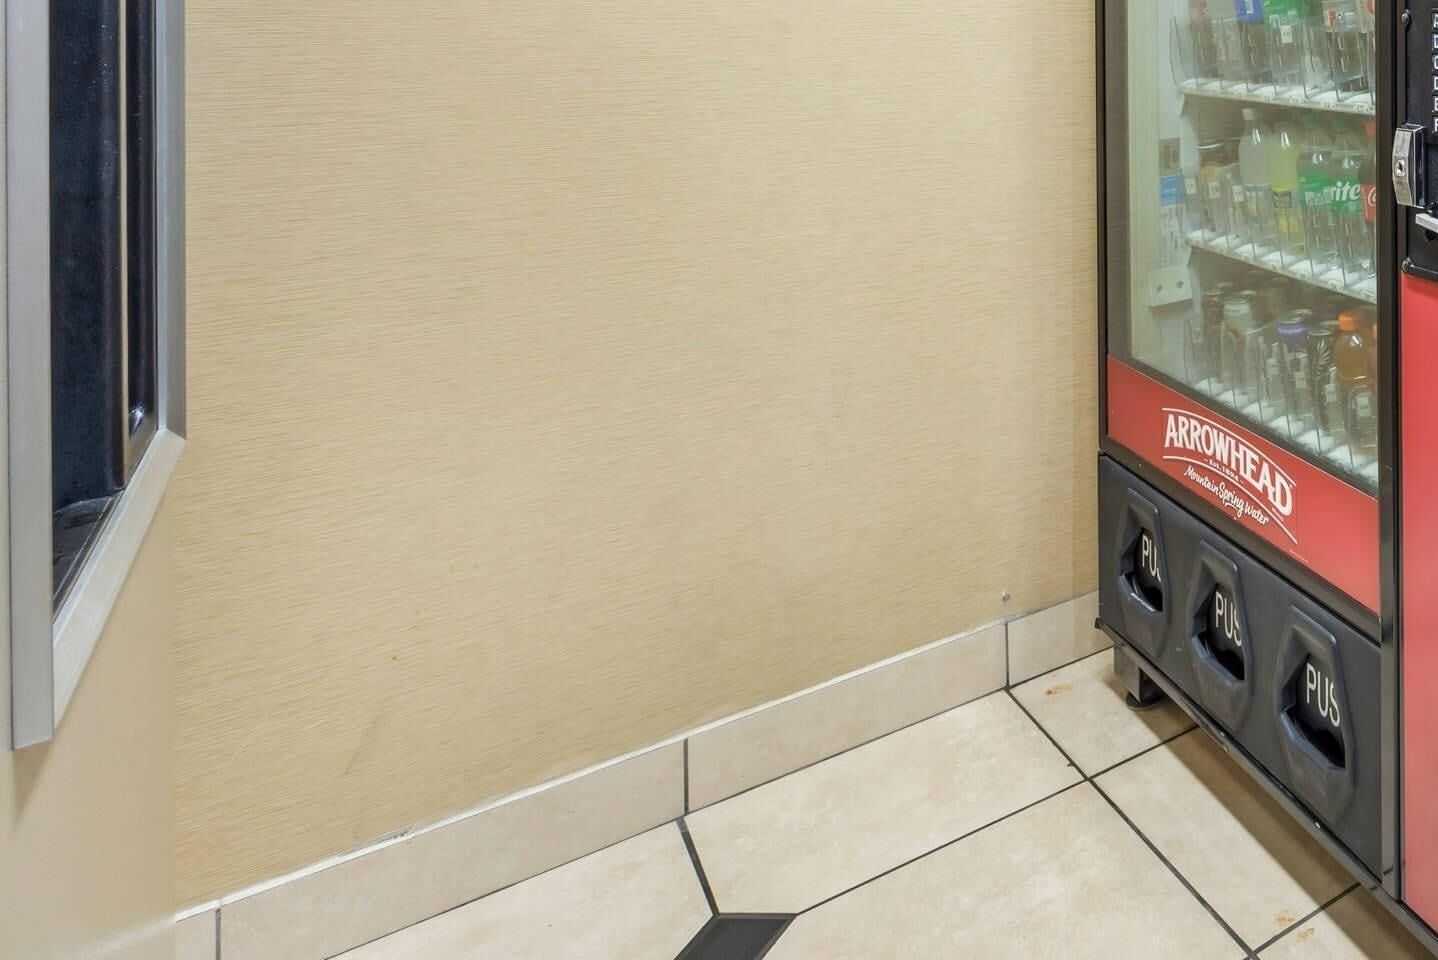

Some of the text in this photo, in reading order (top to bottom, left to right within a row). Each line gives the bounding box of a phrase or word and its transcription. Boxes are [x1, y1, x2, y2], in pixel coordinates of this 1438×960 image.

[1164, 413, 1293, 517] ARROWHEAD
[1183, 464, 1270, 526] Mountain Spring Water
